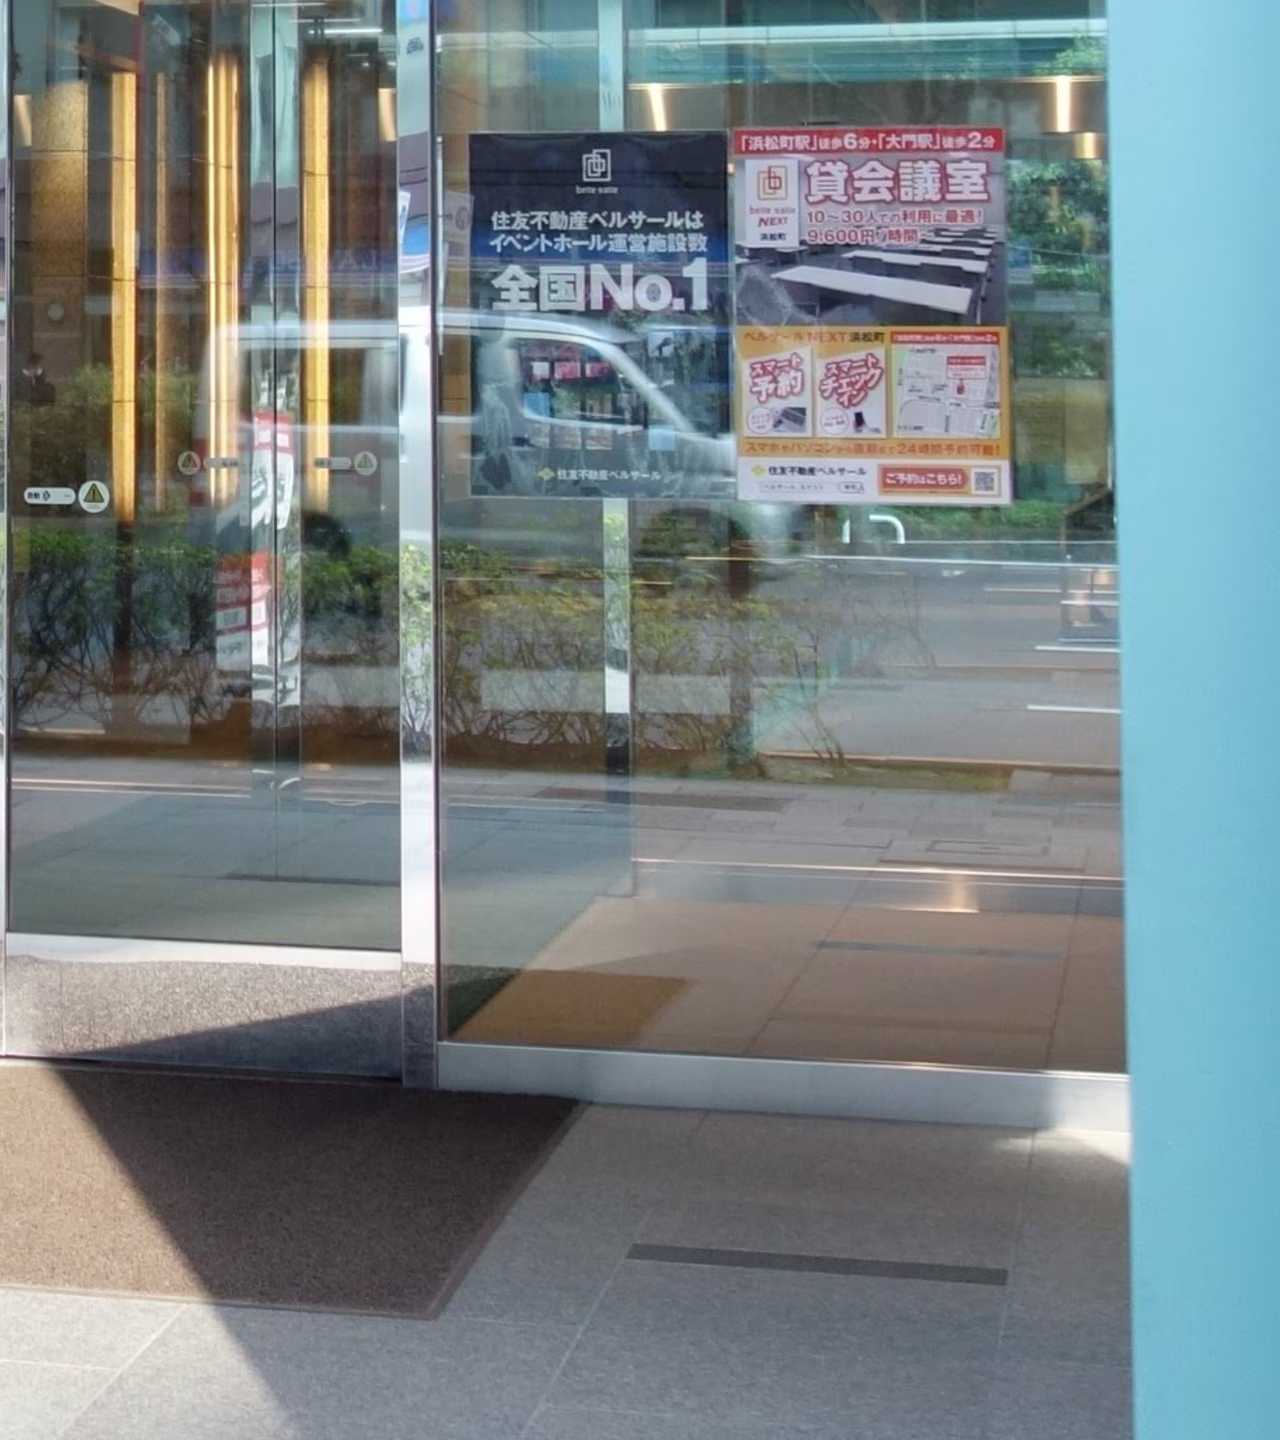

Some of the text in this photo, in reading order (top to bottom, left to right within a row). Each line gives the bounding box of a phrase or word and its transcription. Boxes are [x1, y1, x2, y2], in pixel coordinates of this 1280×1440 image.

[805, 160, 990, 204] 貸会議室
[492, 211, 704, 231] 住友不動産ベルサールは
[490, 233, 708, 253] イベントホール運営施設数
[491, 257, 708, 311] 全国No.1
